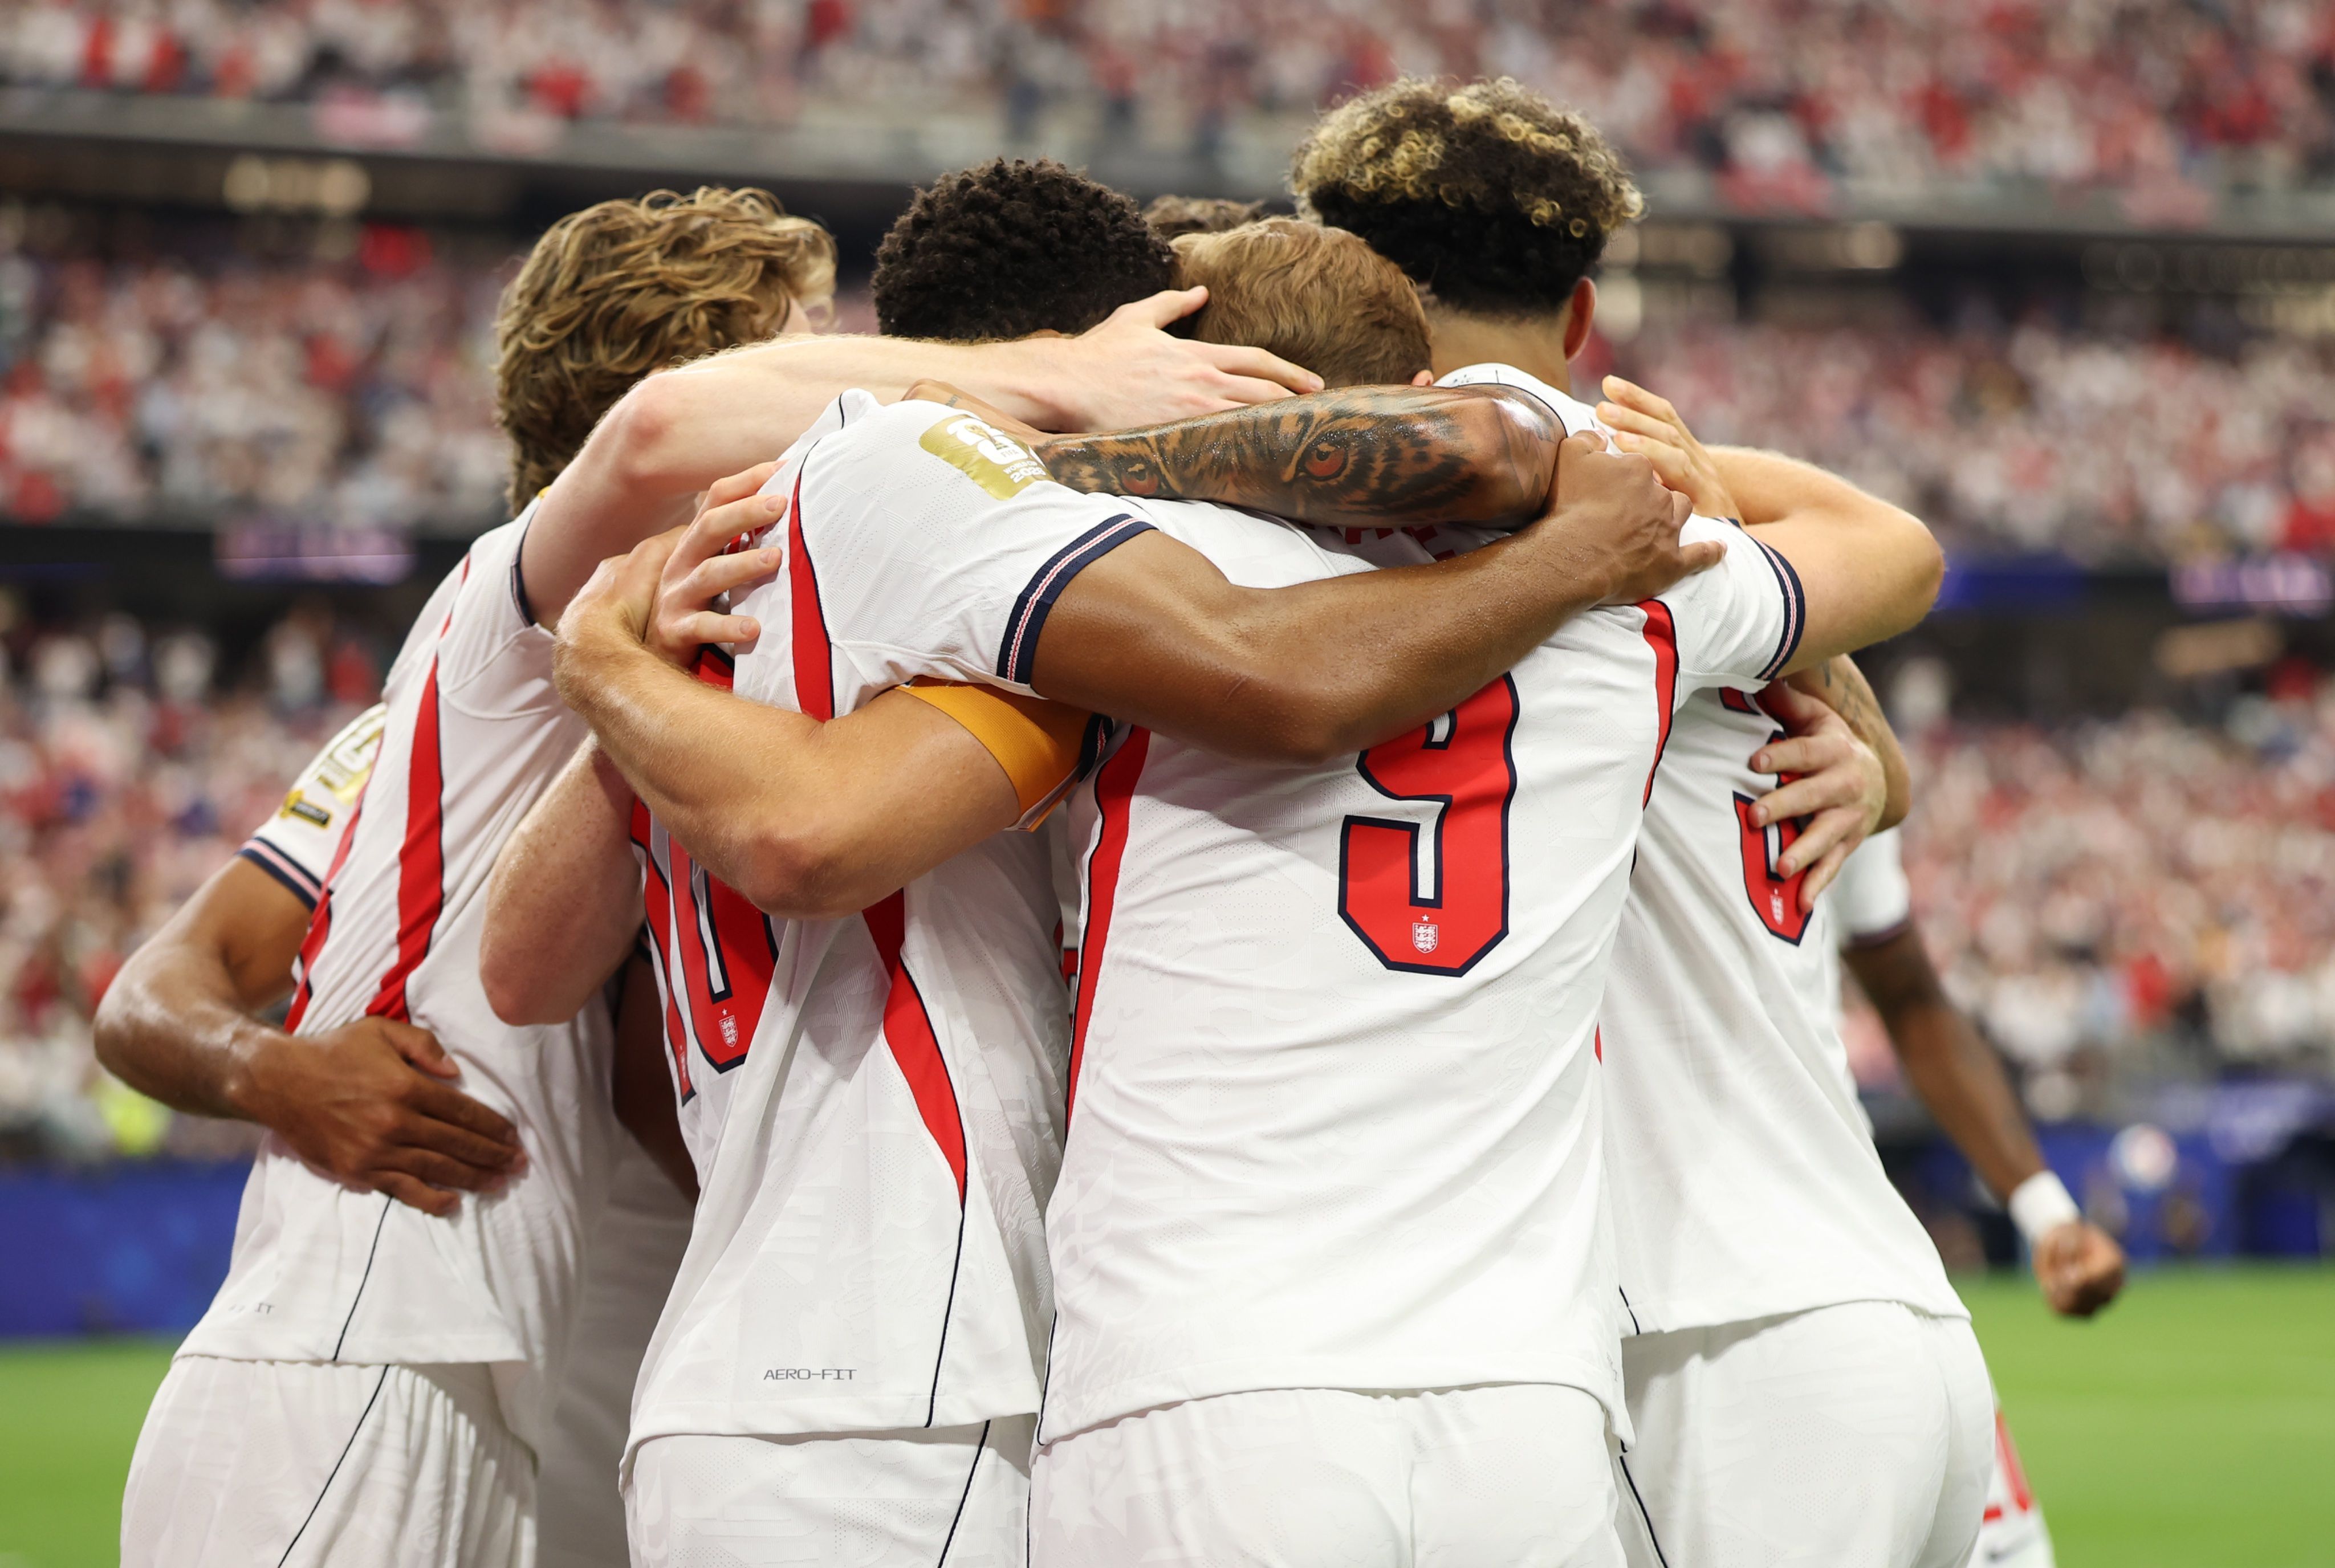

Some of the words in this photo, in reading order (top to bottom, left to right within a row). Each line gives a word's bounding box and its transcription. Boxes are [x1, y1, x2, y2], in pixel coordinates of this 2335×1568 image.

[1010, 467, 1047, 483] 2026
[1337, 671, 1520, 978] 9
[763, 1369, 857, 1380] AERO-FIT
